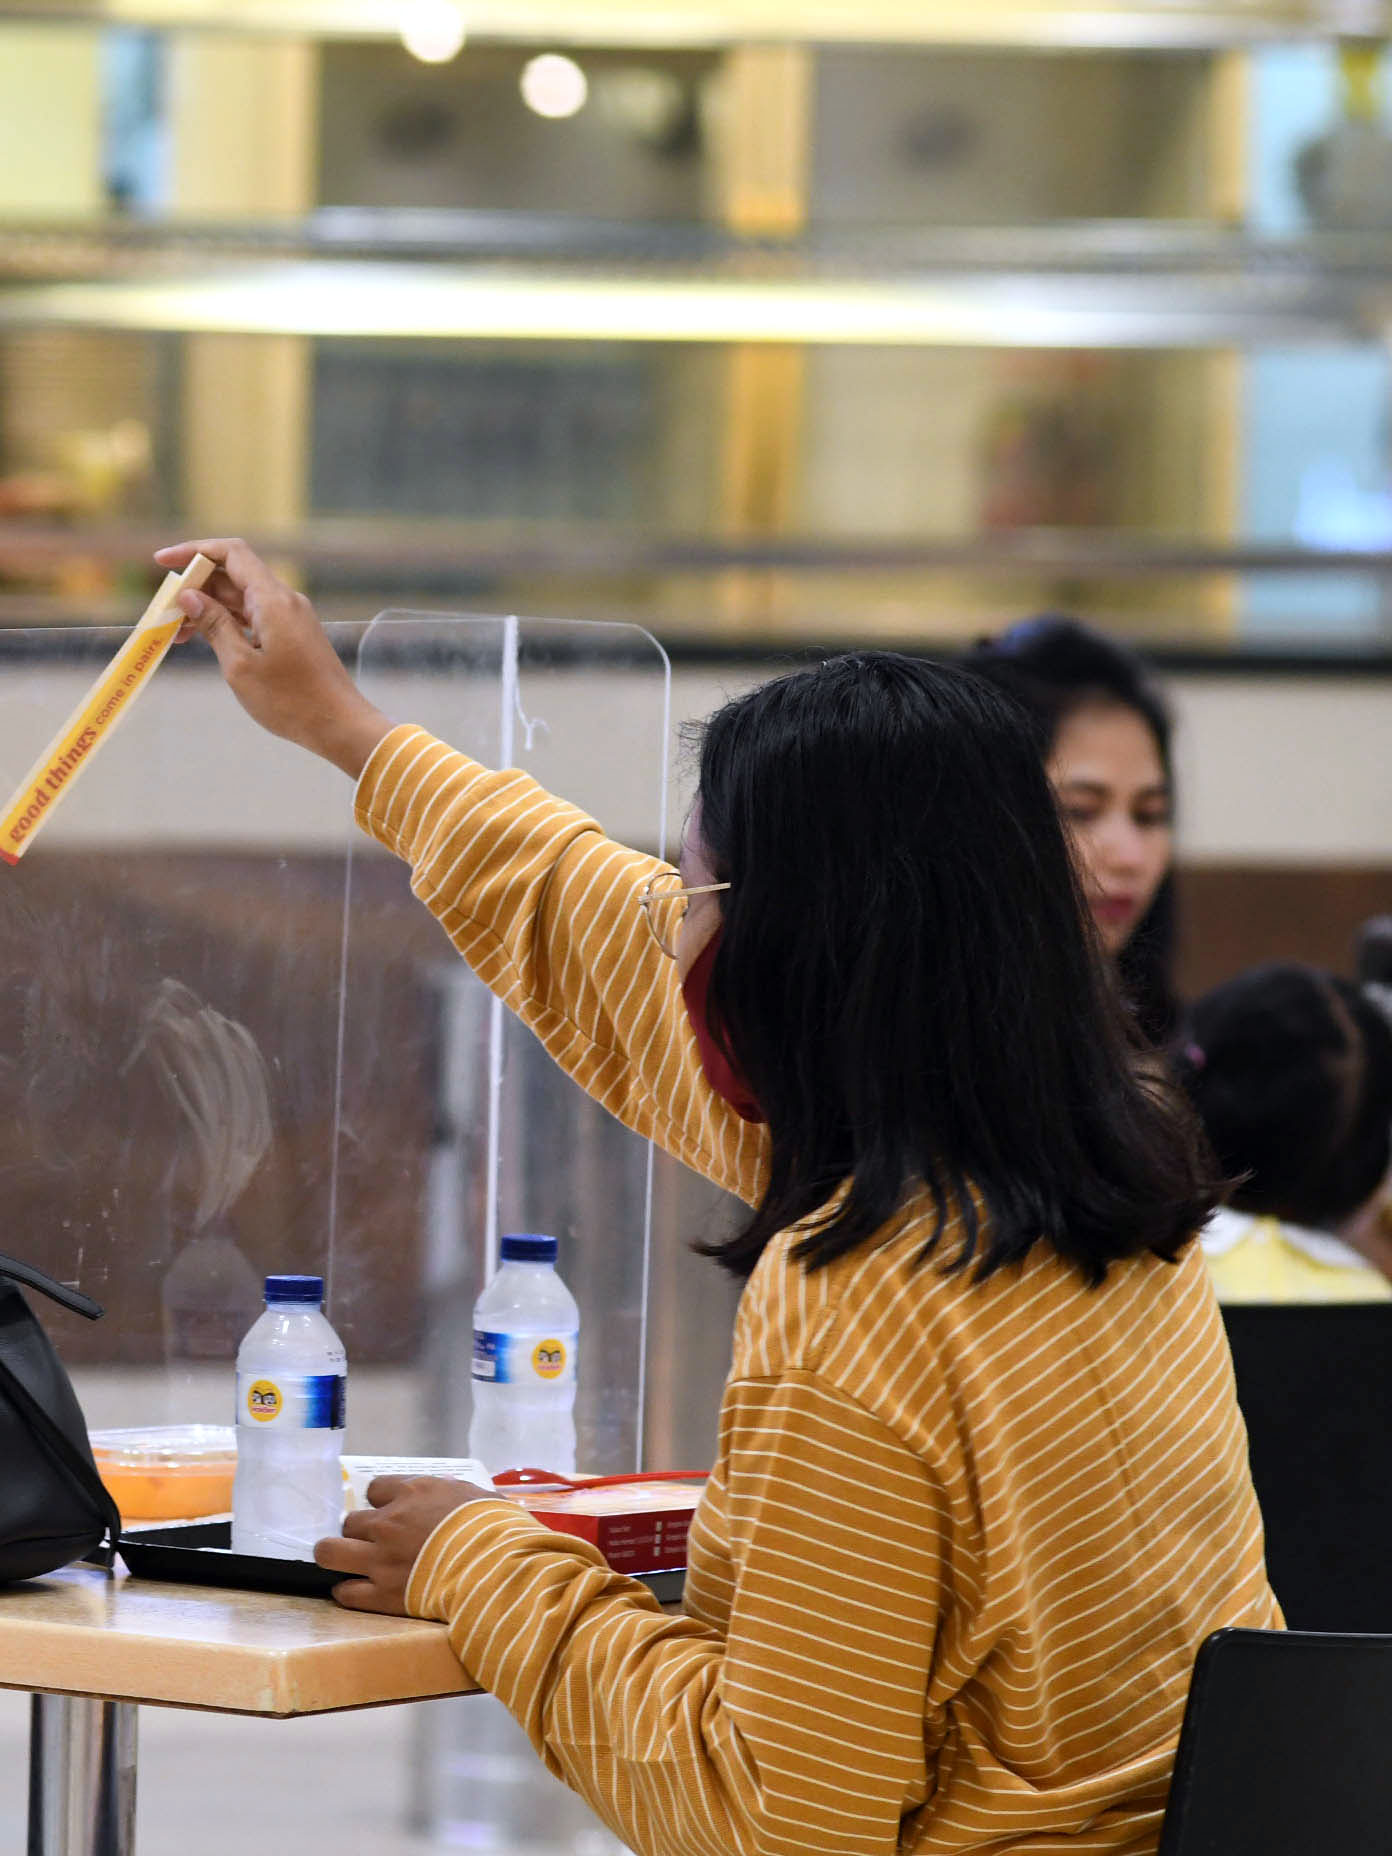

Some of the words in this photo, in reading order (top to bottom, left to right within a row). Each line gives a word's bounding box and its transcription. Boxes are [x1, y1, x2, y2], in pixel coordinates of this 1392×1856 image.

[10, 787, 51, 843] good
[45, 725, 98, 790] things
[95, 689, 125, 725] come
[122, 672, 137, 687] in
[134, 637, 163, 673] pairs
